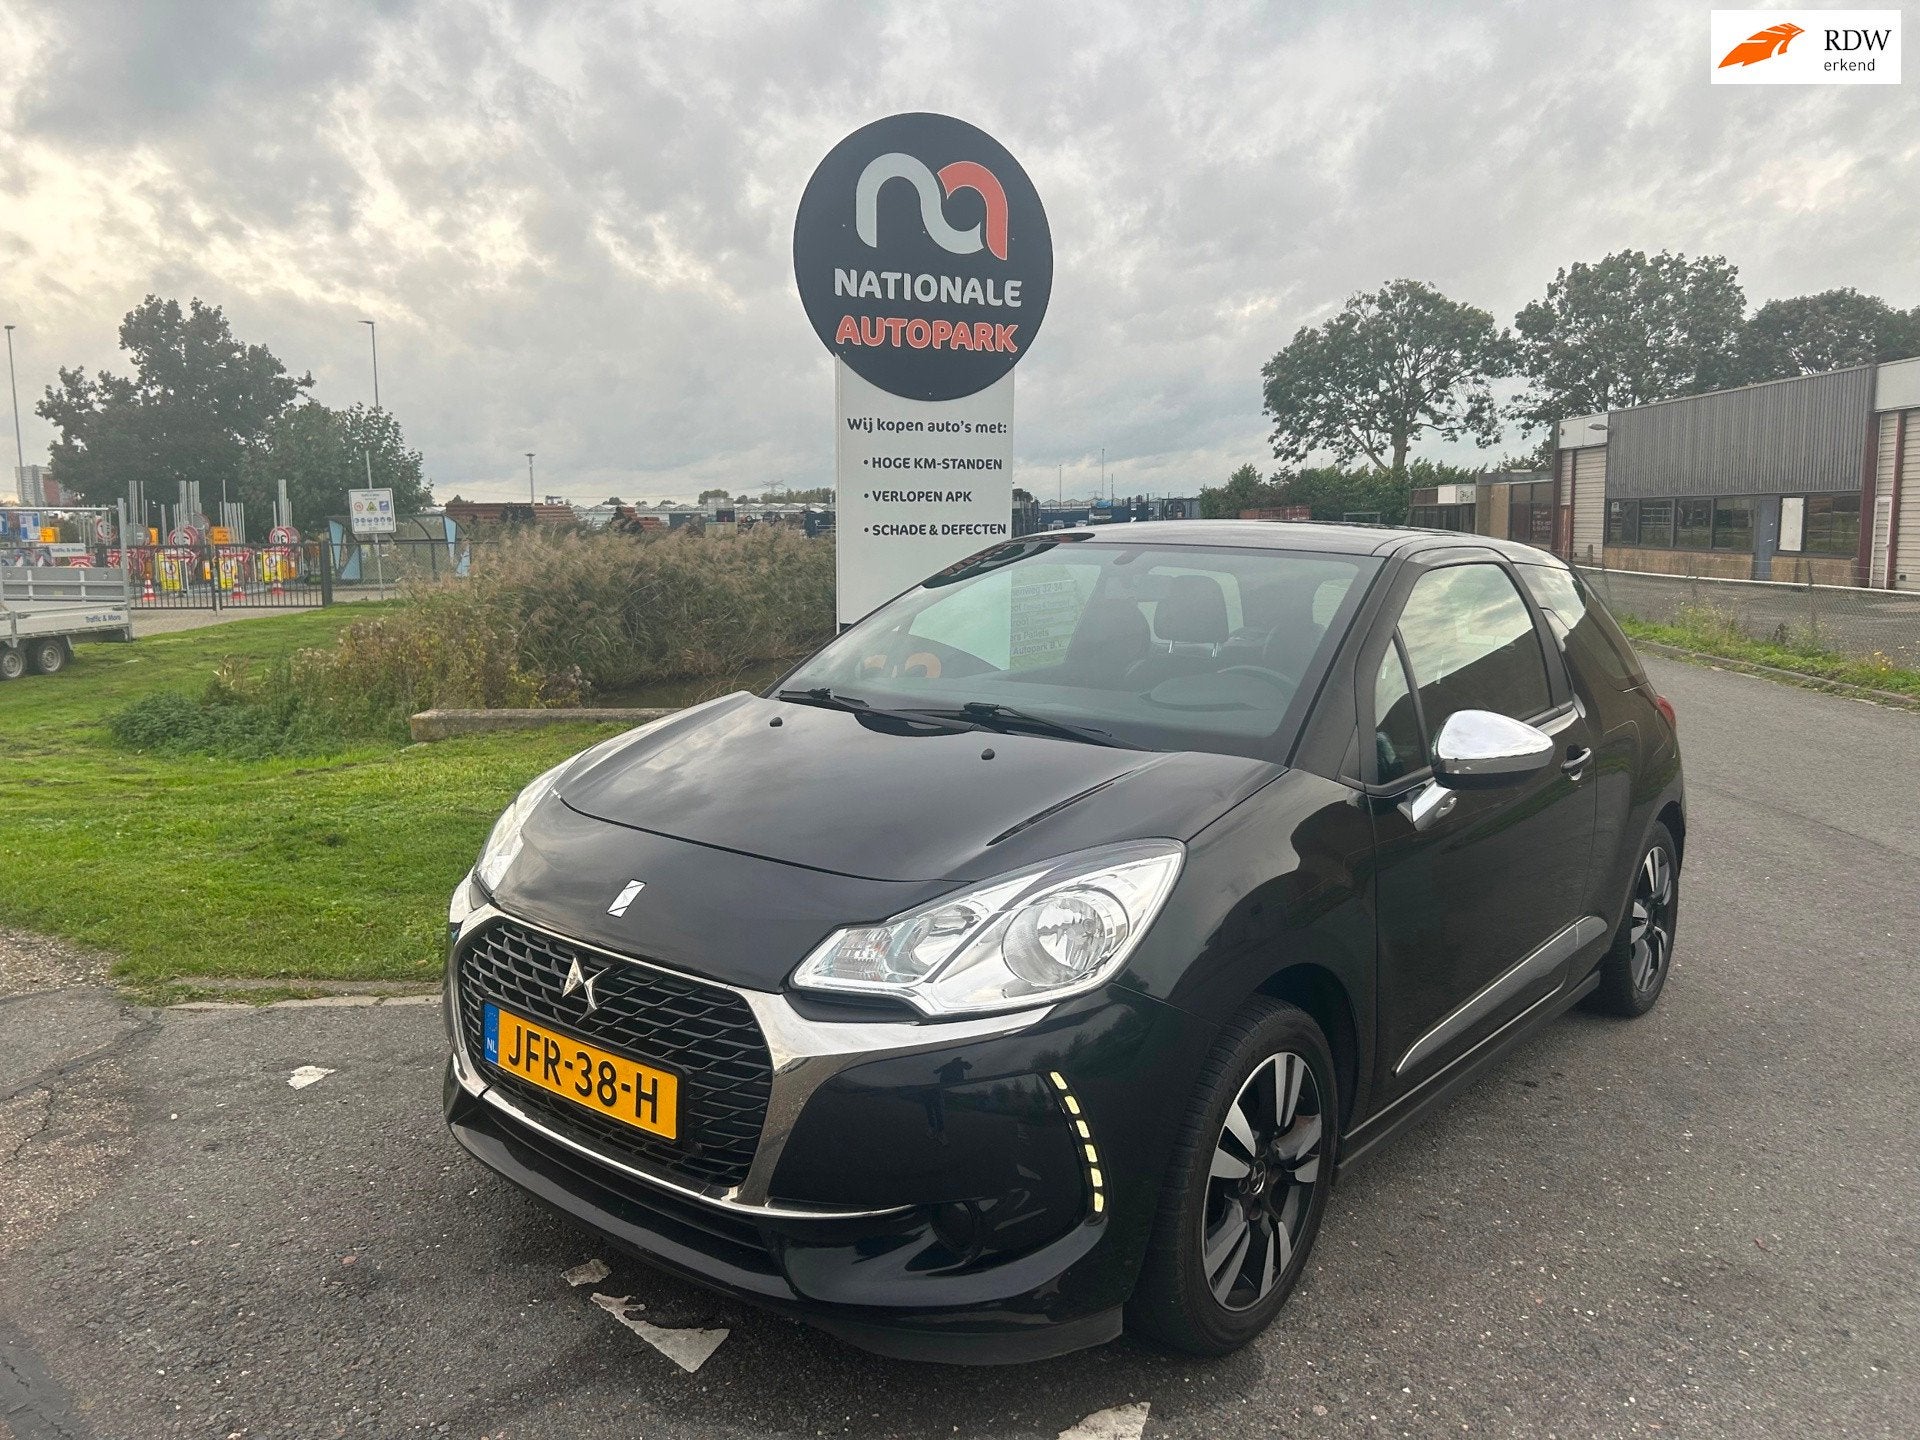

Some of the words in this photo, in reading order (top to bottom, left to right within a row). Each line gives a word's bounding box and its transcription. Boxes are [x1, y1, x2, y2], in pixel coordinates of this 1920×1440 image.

[834, 268, 1022, 307] NATIONALE
[835, 315, 1019, 353] AUTOPARK
[847, 418, 873, 433] Wij
[877, 418, 924, 433] kopen
[927, 420, 972, 433] auto's
[975, 421, 1007, 434] met:
[872, 457, 911, 469] HOGE
[914, 458, 1003, 470] KM-STANDEN
[872, 490, 943, 502] VERLOPEN
[945, 491, 973, 502] APK
[872, 524, 927, 536] SCHADE
[929, 524, 938, 535] &
[941, 523, 1007, 535] DEFECTEN
[486, 1037, 497, 1054] NL
[508, 1025, 658, 1124] JFR-38-H
